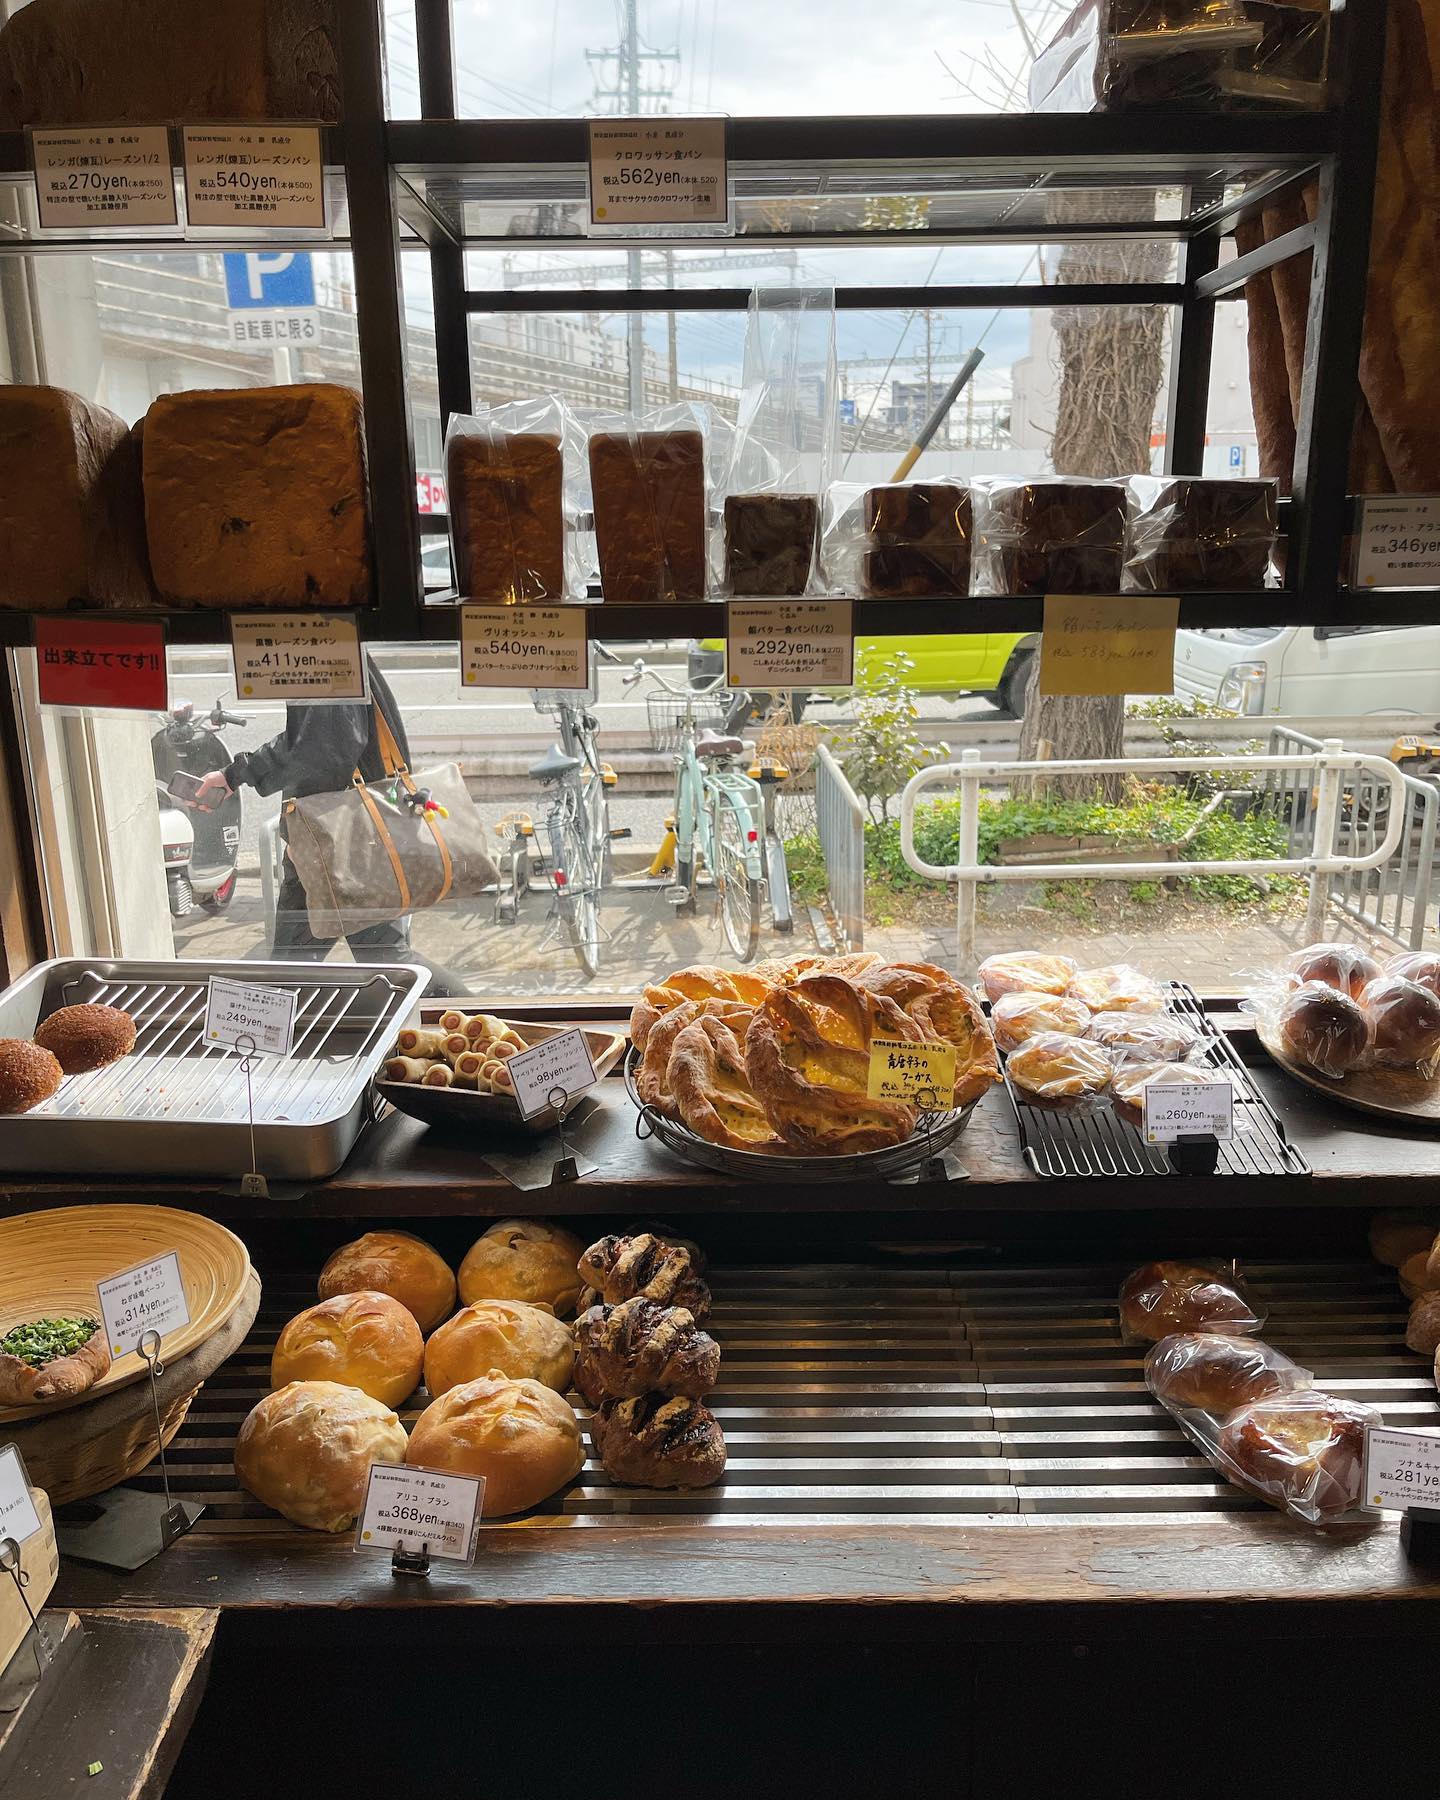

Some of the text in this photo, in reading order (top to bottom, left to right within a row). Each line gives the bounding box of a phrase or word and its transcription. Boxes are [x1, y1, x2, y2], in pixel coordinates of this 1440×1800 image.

[615, 150, 702, 160] クロワッサン食パン
[245, 253, 295, 299] P
[234, 319, 314, 340] 自転車に限る
[44, 648, 159, 671] 出来立てです!!
[888, 1053, 928, 1069] 青唐辛子の
[901, 1072, 933, 1083] フーガス
